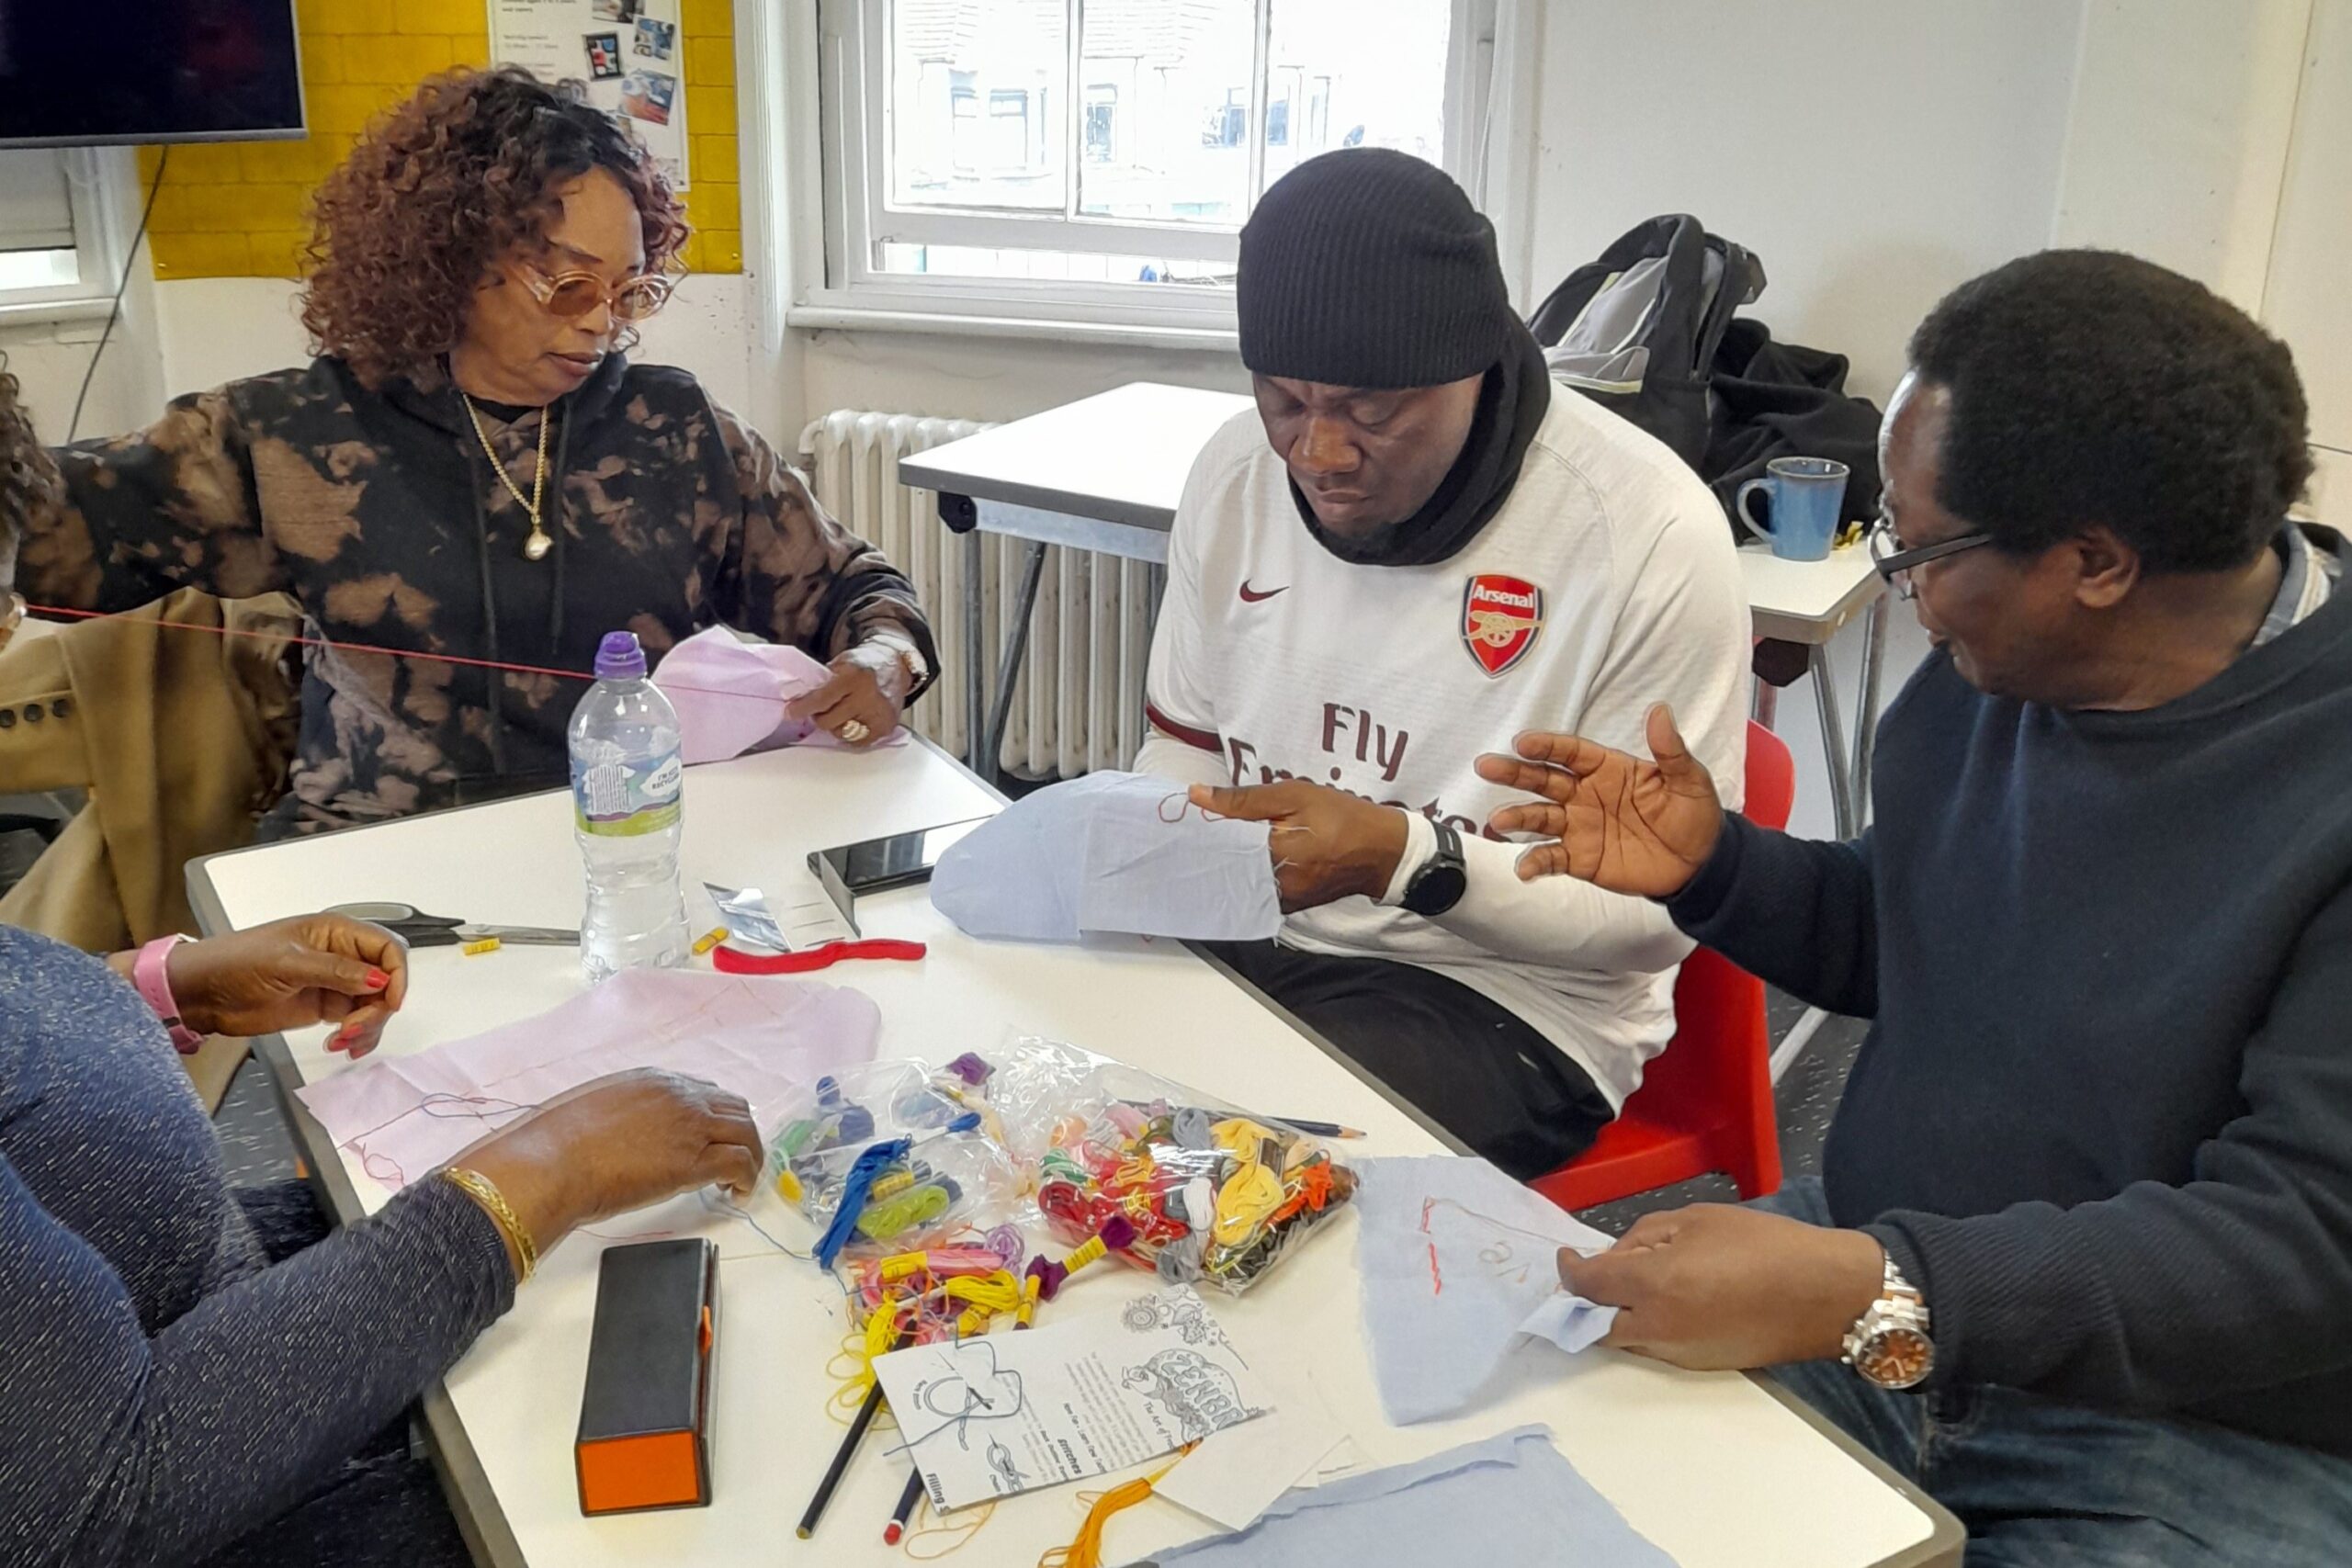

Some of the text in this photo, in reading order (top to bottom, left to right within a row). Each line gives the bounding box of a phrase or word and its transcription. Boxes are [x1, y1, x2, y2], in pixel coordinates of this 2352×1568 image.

[1474, 584, 1533, 608] Arsenal
[1322, 702, 1408, 781] Fly
[1057, 1438, 1082, 1474] Stitches
[925, 1472, 945, 1505] Filling
